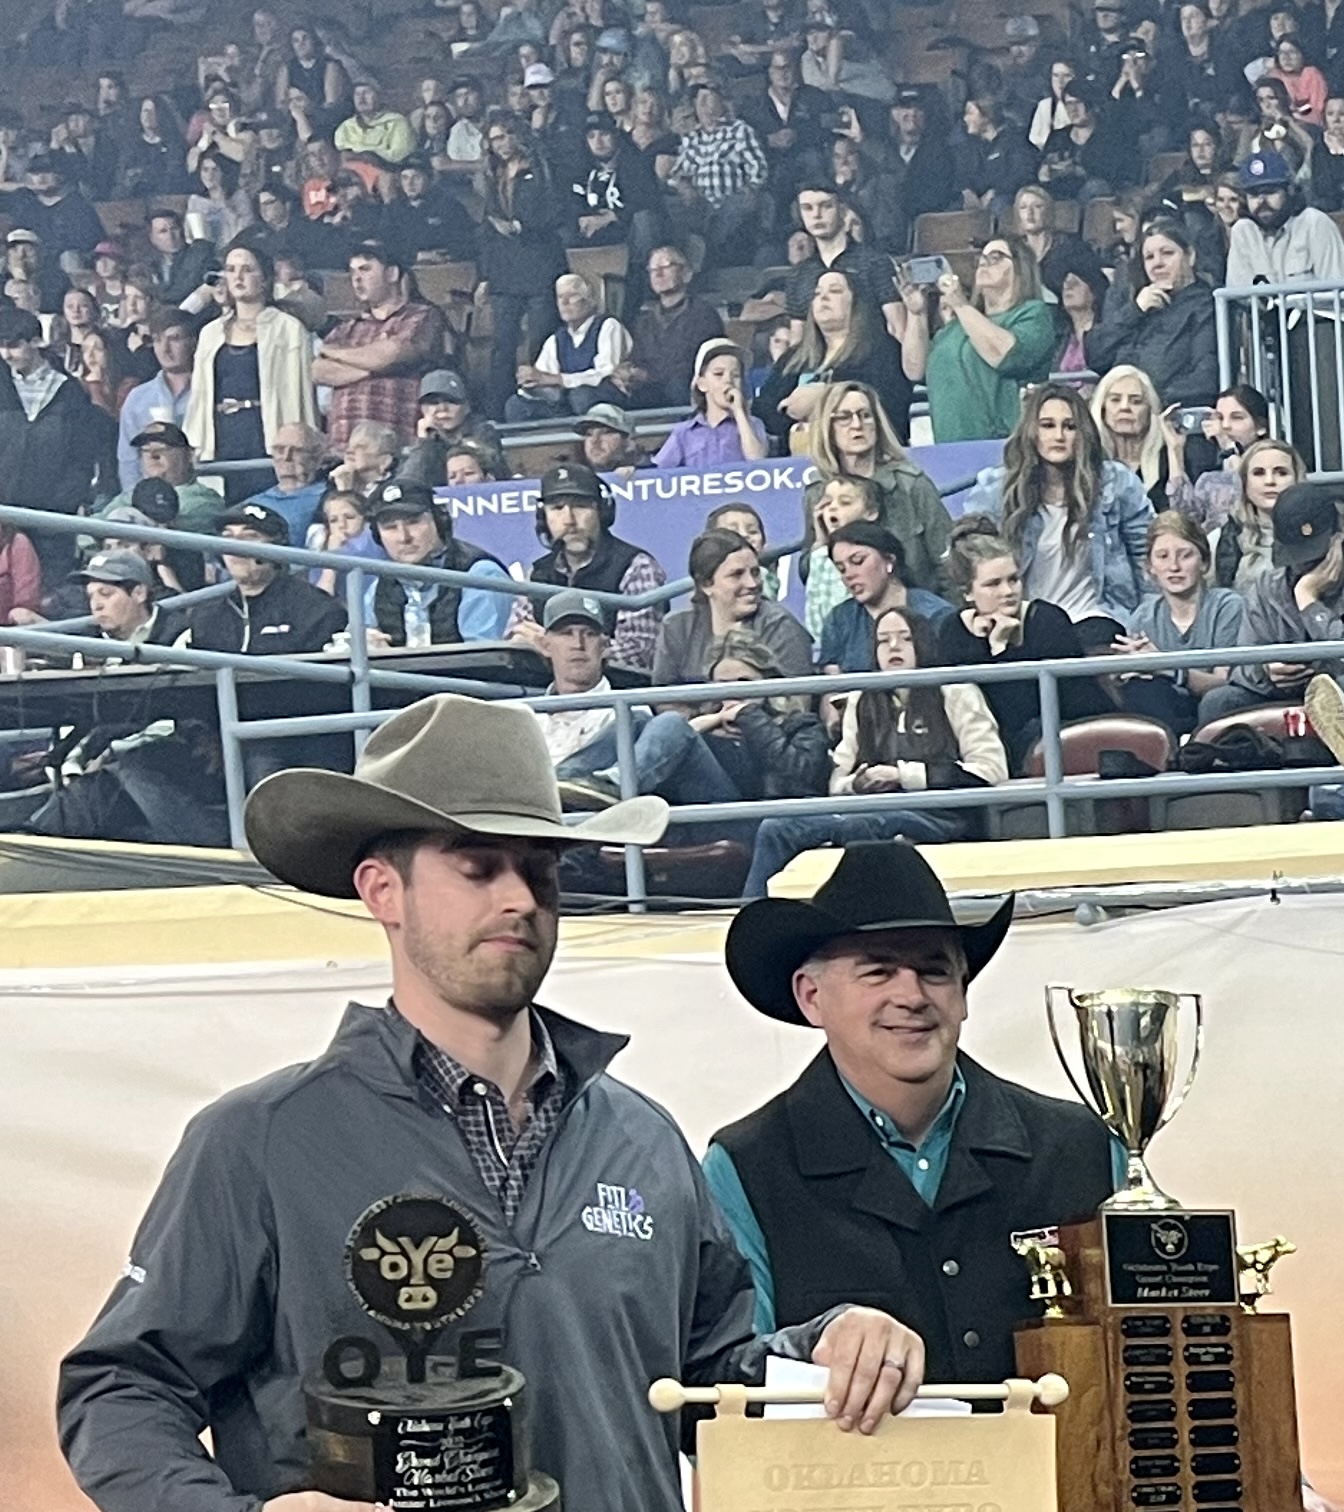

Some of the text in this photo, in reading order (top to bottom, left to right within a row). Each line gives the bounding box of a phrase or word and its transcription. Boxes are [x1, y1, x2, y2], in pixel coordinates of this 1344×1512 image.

[581, 1206, 654, 1240] GENETICS
[323, 1327, 503, 1389] OYE
[763, 1459, 991, 1492] OKLAHOMA
